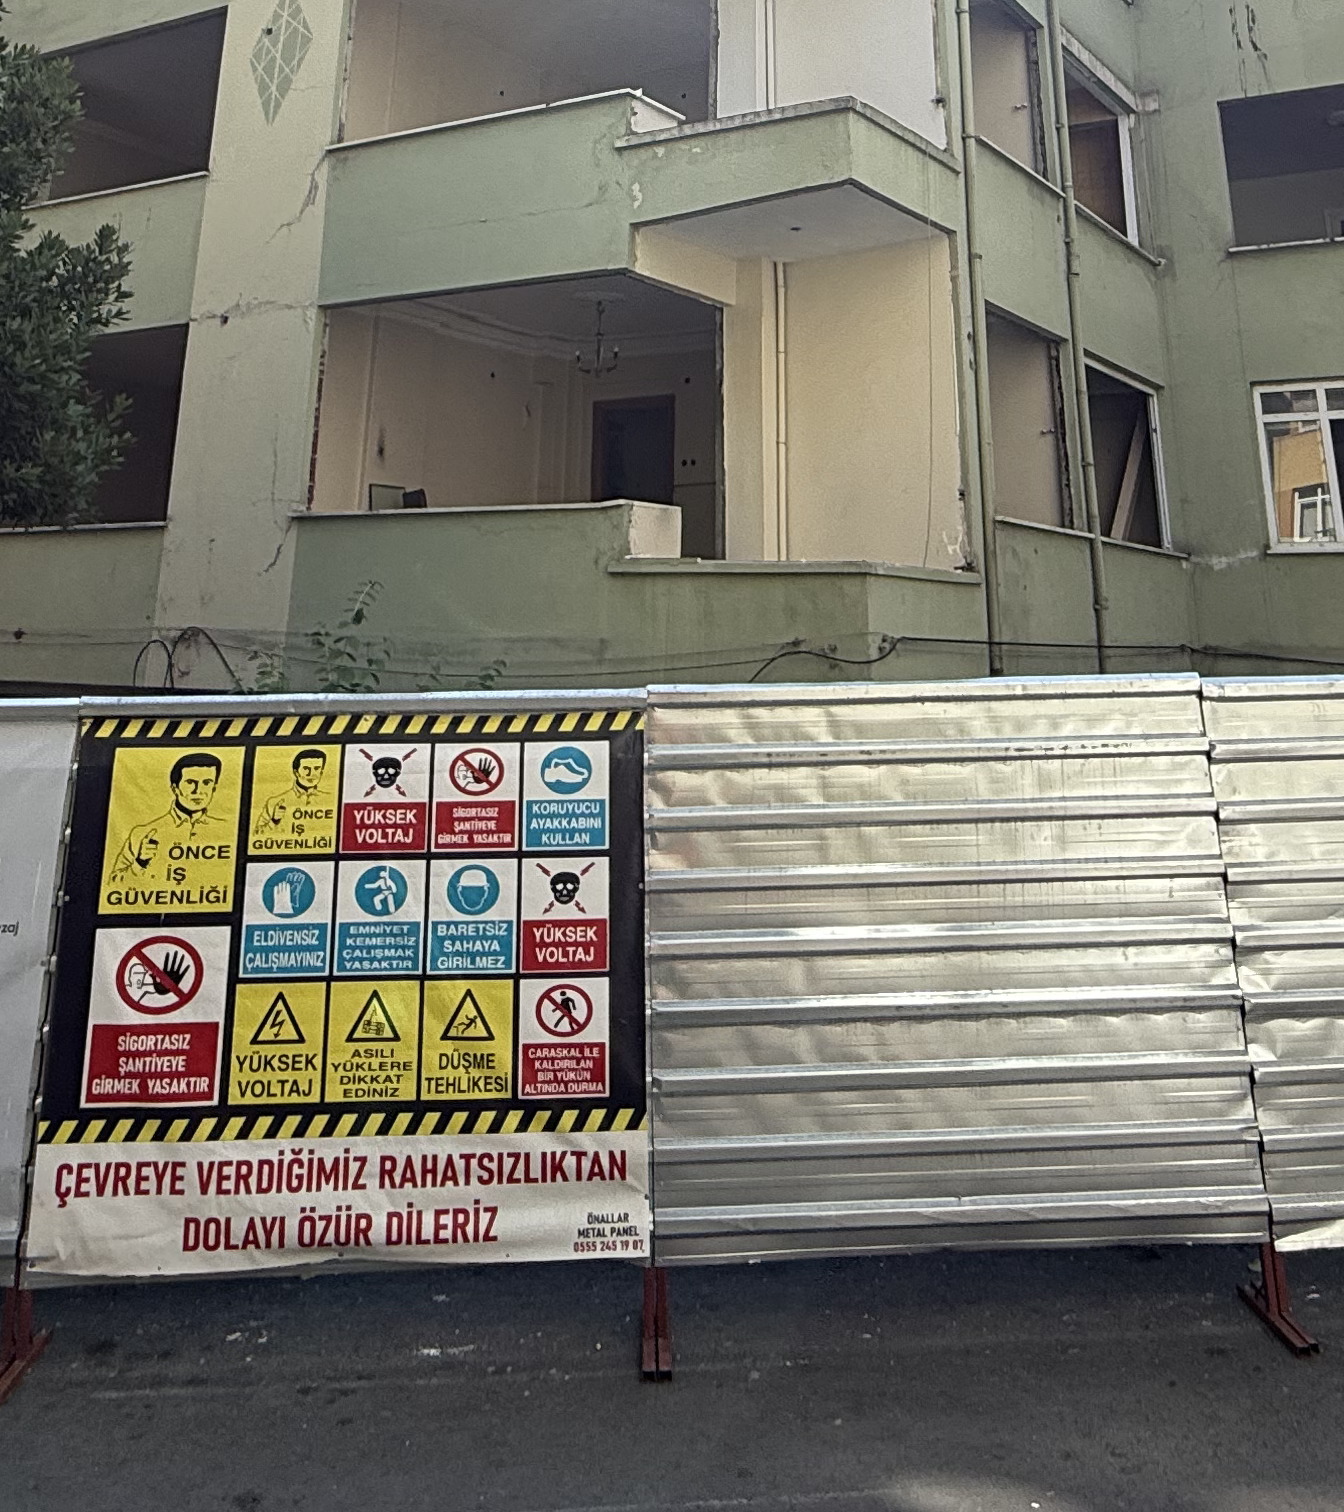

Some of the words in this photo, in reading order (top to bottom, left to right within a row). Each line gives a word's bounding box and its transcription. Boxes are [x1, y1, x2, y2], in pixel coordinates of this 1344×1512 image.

[292, 808, 334, 820] ÖNCE
[353, 806, 417, 825] YÜKSEK
[452, 806, 499, 818] SİGORTASIZ
[532, 802, 600, 815] KORUYUCU
[291, 822, 305, 836] İŞ
[454, 818, 497, 833] ŞANTİYEYE
[530, 817, 602, 830] AYAKKABINI
[355, 828, 413, 844] VOLTAJ
[438, 832, 470, 845] GİRMEK
[473, 833, 513, 844] YASAKTIR
[541, 833, 590, 845] KULLAN
[168, 841, 231, 860] ÖNCE
[252, 837, 332, 850] GÜVENLİĞİ
[166, 864, 187, 885] İŞ
[107, 885, 228, 905] GÜVENLİĞİ
[349, 924, 410, 934] EMNİYET
[437, 920, 508, 936] BARETSİZ
[533, 924, 598, 943] YÜKSEK
[253, 926, 319, 946] ELDİVENSİZ
[346, 936, 416, 947] KEMERSİZ
[443, 940, 500, 953] SAHAYA
[342, 948, 414, 960] ÇALIŞMAK
[535, 947, 594, 962] VOLTAJ
[245, 951, 324, 972] ÇALIŞMAYINIZ
[344, 960, 412, 970] YASAKTIR
[437, 954, 505, 969] GİRİLMEZ
[117, 1032, 191, 1051] SİGORTASIZ
[351, 1048, 394, 1059] ASILI
[528, 1047, 582, 1059] CARASKAL
[584, 1045, 600, 1057] İLE
[118, 1052, 187, 1076] ŞANTİYEYE
[236, 1051, 318, 1073] YÜKSEK
[331, 1060, 413, 1072] YÜKLERE
[439, 1048, 496, 1075] DÜŞME
[534, 1059, 593, 1070] KALDIRILAN
[339, 1073, 404, 1085] DİKKAT
[425, 1071, 509, 1094] TEHLİKESİ
[537, 1070, 554, 1081] BİR
[556, 1070, 591, 1081] YÜKÜN
[92, 1075, 140, 1094] GİRMEK
[147, 1076, 209, 1094] YASAKTIR
[238, 1078, 312, 1098] VOLTAJ
[343, 1085, 400, 1098] EDİNİZ
[524, 1083, 566, 1094] ALTINDA
[567, 1082, 603, 1093] DURMA
[55, 1161, 187, 1208] ÇEVREYE
[197, 1147, 368, 1196] VERDİĞİMİZ
[379, 1149, 627, 1189] RAHATSIZLIKTAN
[182, 1216, 286, 1252] DOLAYI
[298, 1205, 373, 1247] ÖZÜR
[385, 1199, 498, 1246] DİLERİZ
[587, 1212, 630, 1225] ÖNALLAR
[577, 1227, 608, 1239] METAL
[610, 1226, 639, 1237] PANEL
[573, 1240, 597, 1253] 0555
[600, 1240, 617, 1251] 245
[620, 1239, 630, 1251] 19
[632, 1239, 644, 1251] 07
